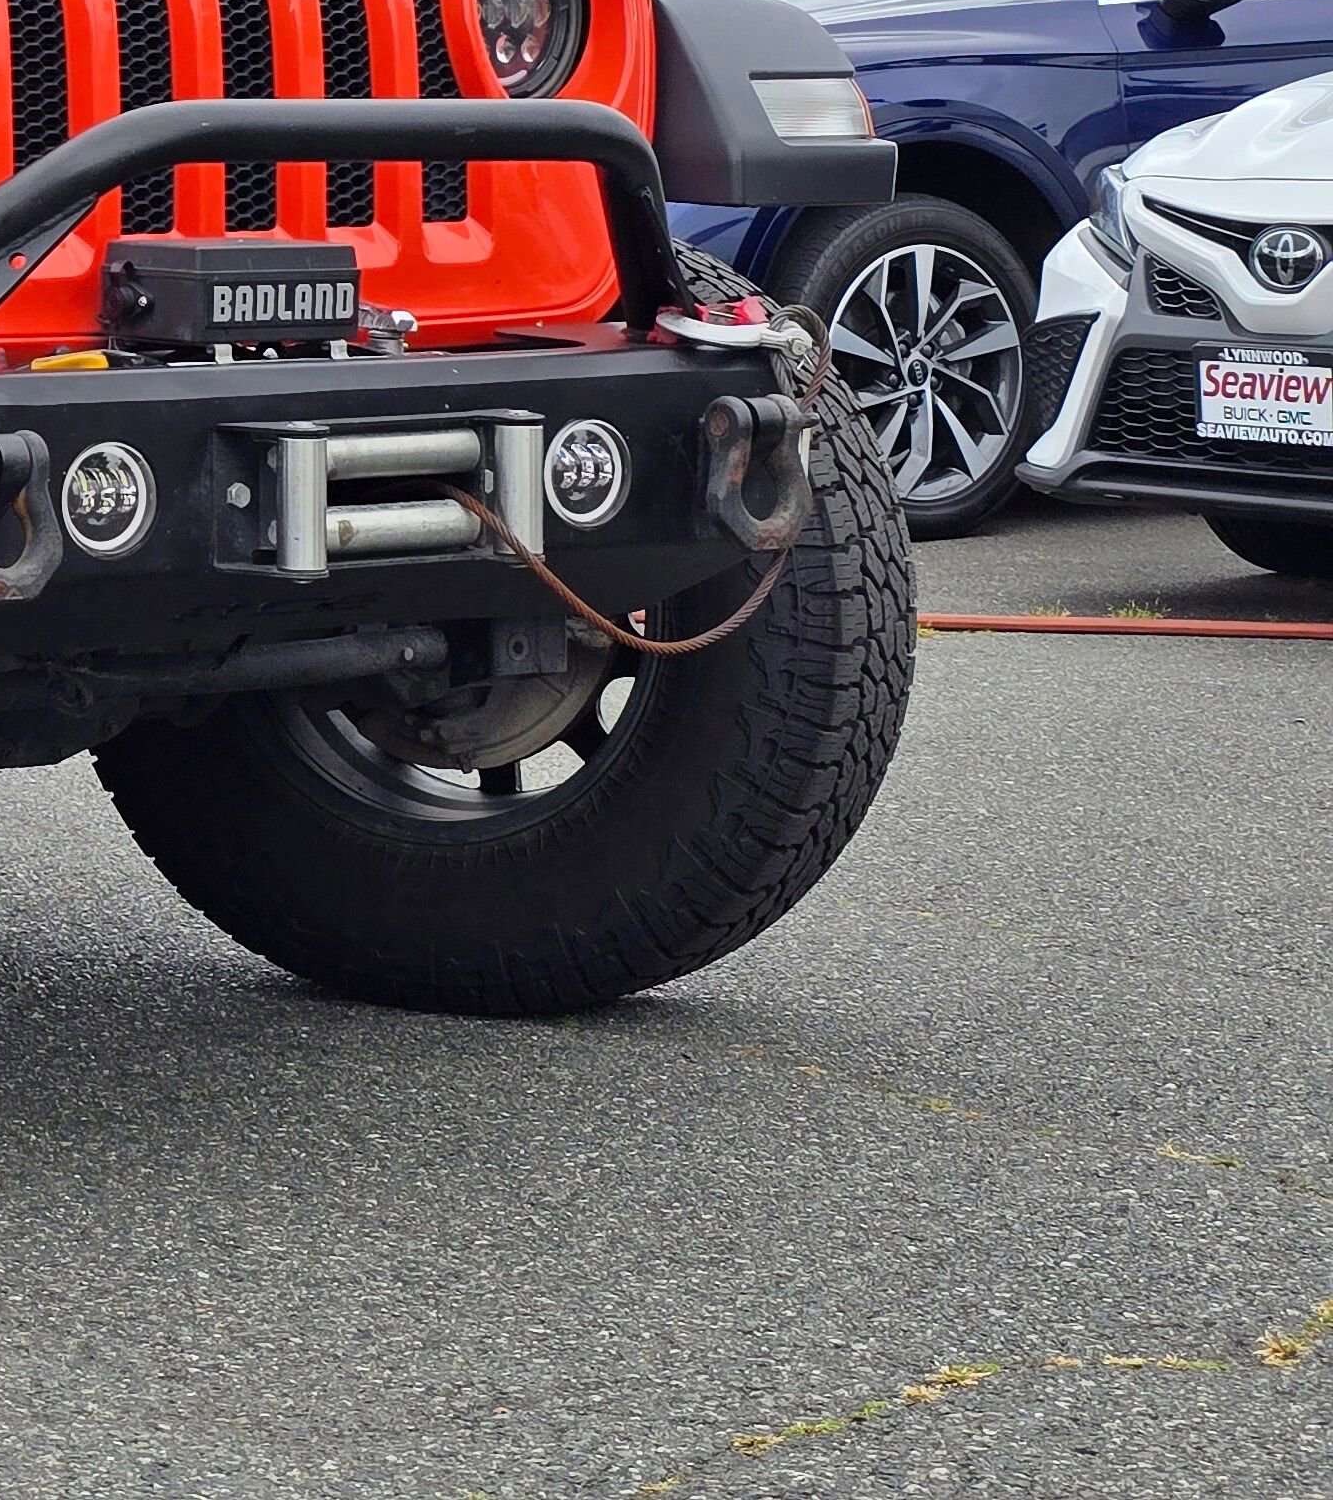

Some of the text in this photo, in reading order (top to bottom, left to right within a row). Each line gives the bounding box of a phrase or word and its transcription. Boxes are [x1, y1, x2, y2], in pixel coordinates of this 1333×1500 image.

[212, 282, 355, 323] BADLAND
[1223, 347, 1303, 365] LYNNWOOD
[1202, 363, 1333, 405] Seaview
[1223, 405, 1314, 426] BUICK GMC
[1196, 422, 1333, 447] SEAVIEWAUTO.COM
